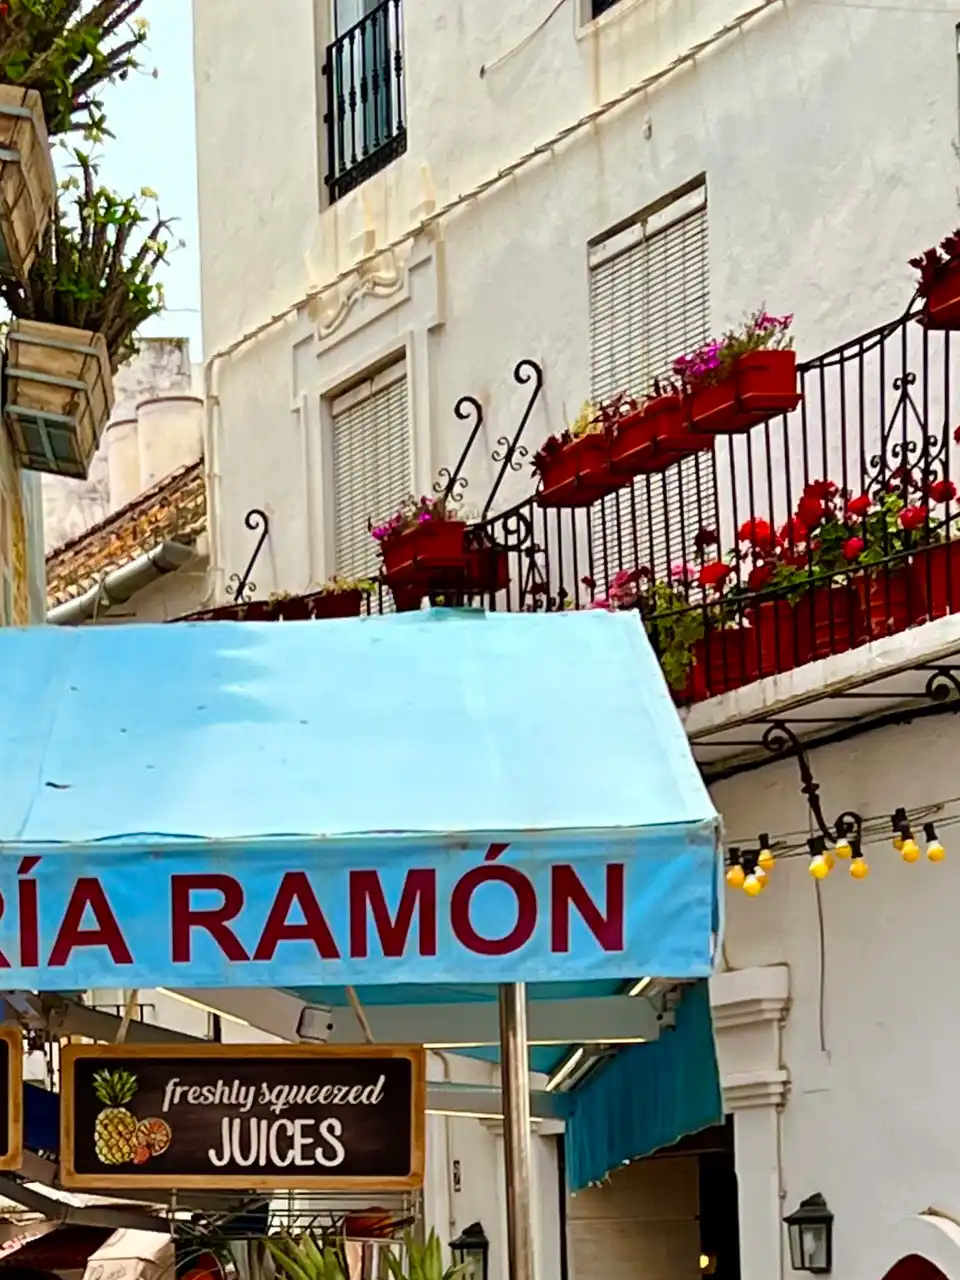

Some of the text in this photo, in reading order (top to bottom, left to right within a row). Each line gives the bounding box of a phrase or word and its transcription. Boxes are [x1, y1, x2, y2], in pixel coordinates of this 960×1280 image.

[171, 843, 625, 963] RAMÓN
[162, 1074, 386, 1115] freshly squeezed
[208, 1116, 346, 1167] JUICES
